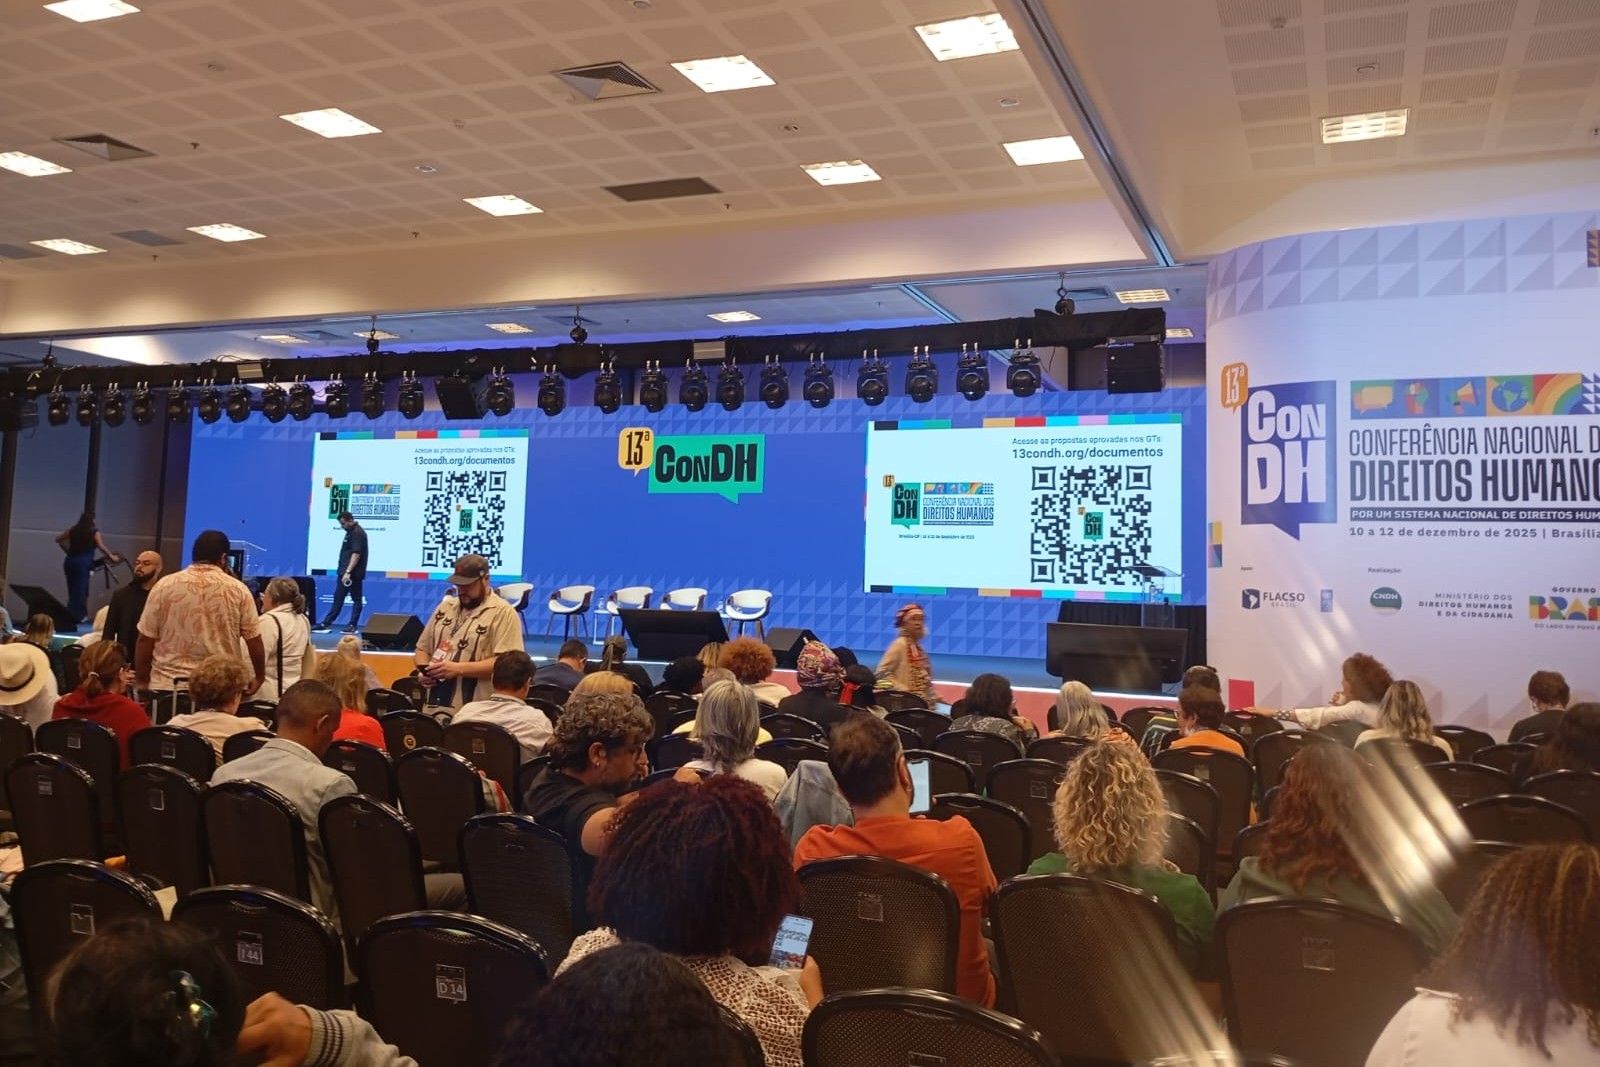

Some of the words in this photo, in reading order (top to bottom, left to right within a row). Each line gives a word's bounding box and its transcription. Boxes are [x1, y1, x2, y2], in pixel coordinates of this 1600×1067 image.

[1050, 436, 1087, 446] propostas
[1089, 435, 1128, 446] aprovadas
[1350, 423, 1479, 456] CONFERÊNCIA
[1485, 425, 1584, 455] NACIONAL
[625, 430, 650, 466] 13ª
[1012, 447, 1163, 460] 13condh.org/documentos
[414, 456, 516, 466] 13condh.org/documentos
[1247, 439, 1327, 504] DH
[1350, 458, 1473, 502] DIREITOS
[330, 498, 349, 514] DH
[893, 500, 918, 519] DH
[923, 506, 955, 520] DIREITOS
[956, 506, 994, 520] HUMANOS
[1351, 510, 1374, 519] POR
[1375, 510, 1393, 519] UM
[1394, 510, 1441, 519] SISTEMA
[1443, 510, 1500, 520] NACIONAL
[1502, 511, 1517, 520] DE
[1519, 511, 1573, 520] DIREITOS
[1350, 527, 1364, 536] 10
[1380, 527, 1394, 536] 12
[1398, 527, 1413, 537] de
[1418, 527, 1480, 537] dezembro
[1485, 528, 1500, 537] de
[1504, 528, 1538, 538] 2025
[1263, 591, 1305, 602] FLACSO
[1493, 593, 1513, 601] DOS
[1465, 602, 1513, 610] HUMANOS
[1460, 611, 1513, 619] CIDADANIA
